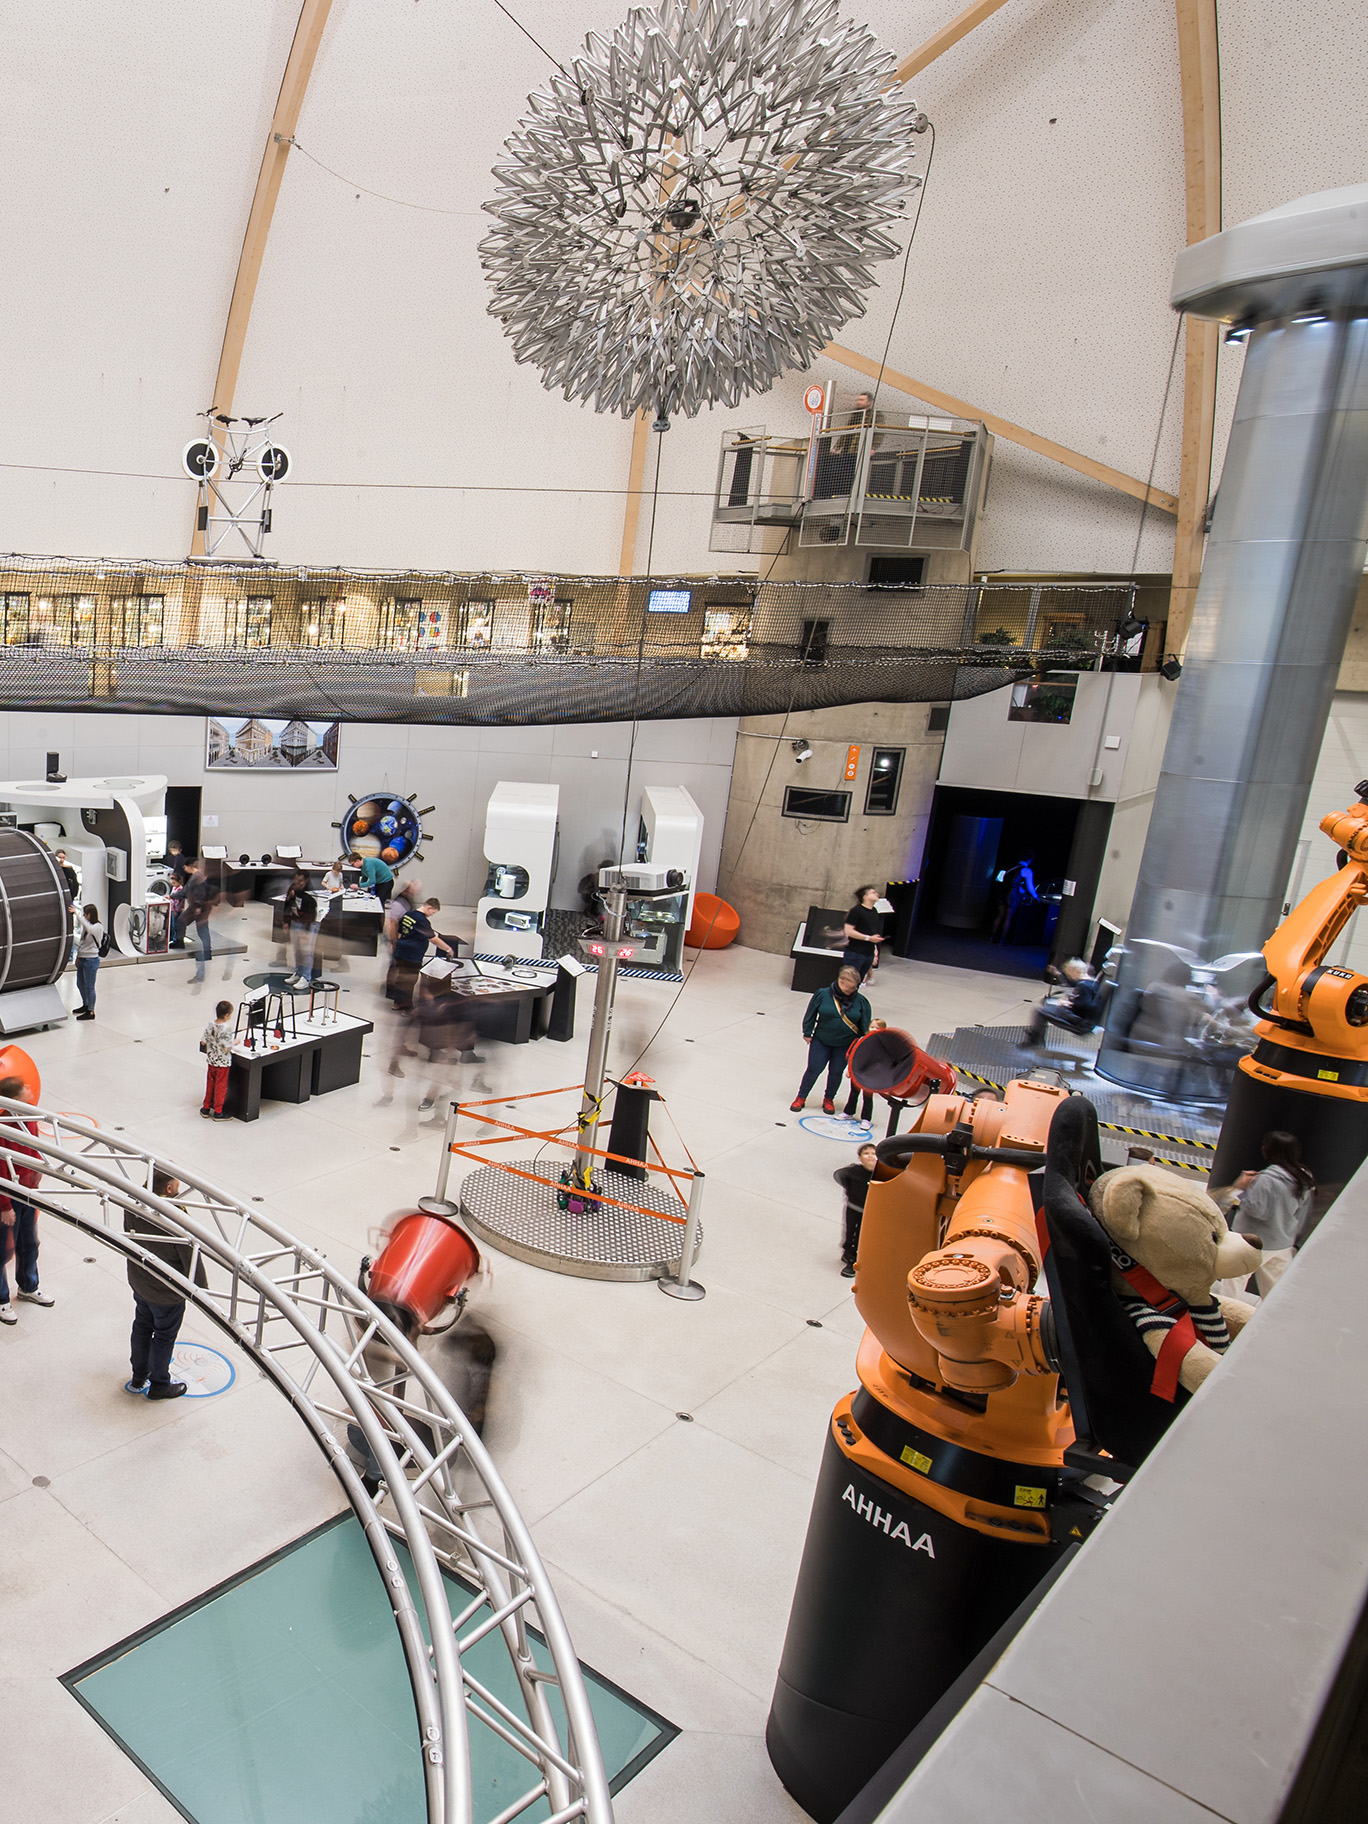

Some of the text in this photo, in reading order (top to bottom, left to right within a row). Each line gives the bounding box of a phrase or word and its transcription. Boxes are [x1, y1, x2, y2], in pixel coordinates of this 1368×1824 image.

[591, 945, 603, 954] 26
[619, 948, 634, 957] 26
[1327, 969, 1352, 979] KUKA
[494, 1120, 516, 1131] AHHAA
[558, 1139, 580, 1149] AHHAA
[487, 1160, 508, 1171] AHHAA
[625, 1158, 649, 1168] AHHAA
[549, 1181, 572, 1192] AHHAA
[616, 1201, 640, 1212] AHHAA
[841, 1483, 936, 1559] AHHAA
